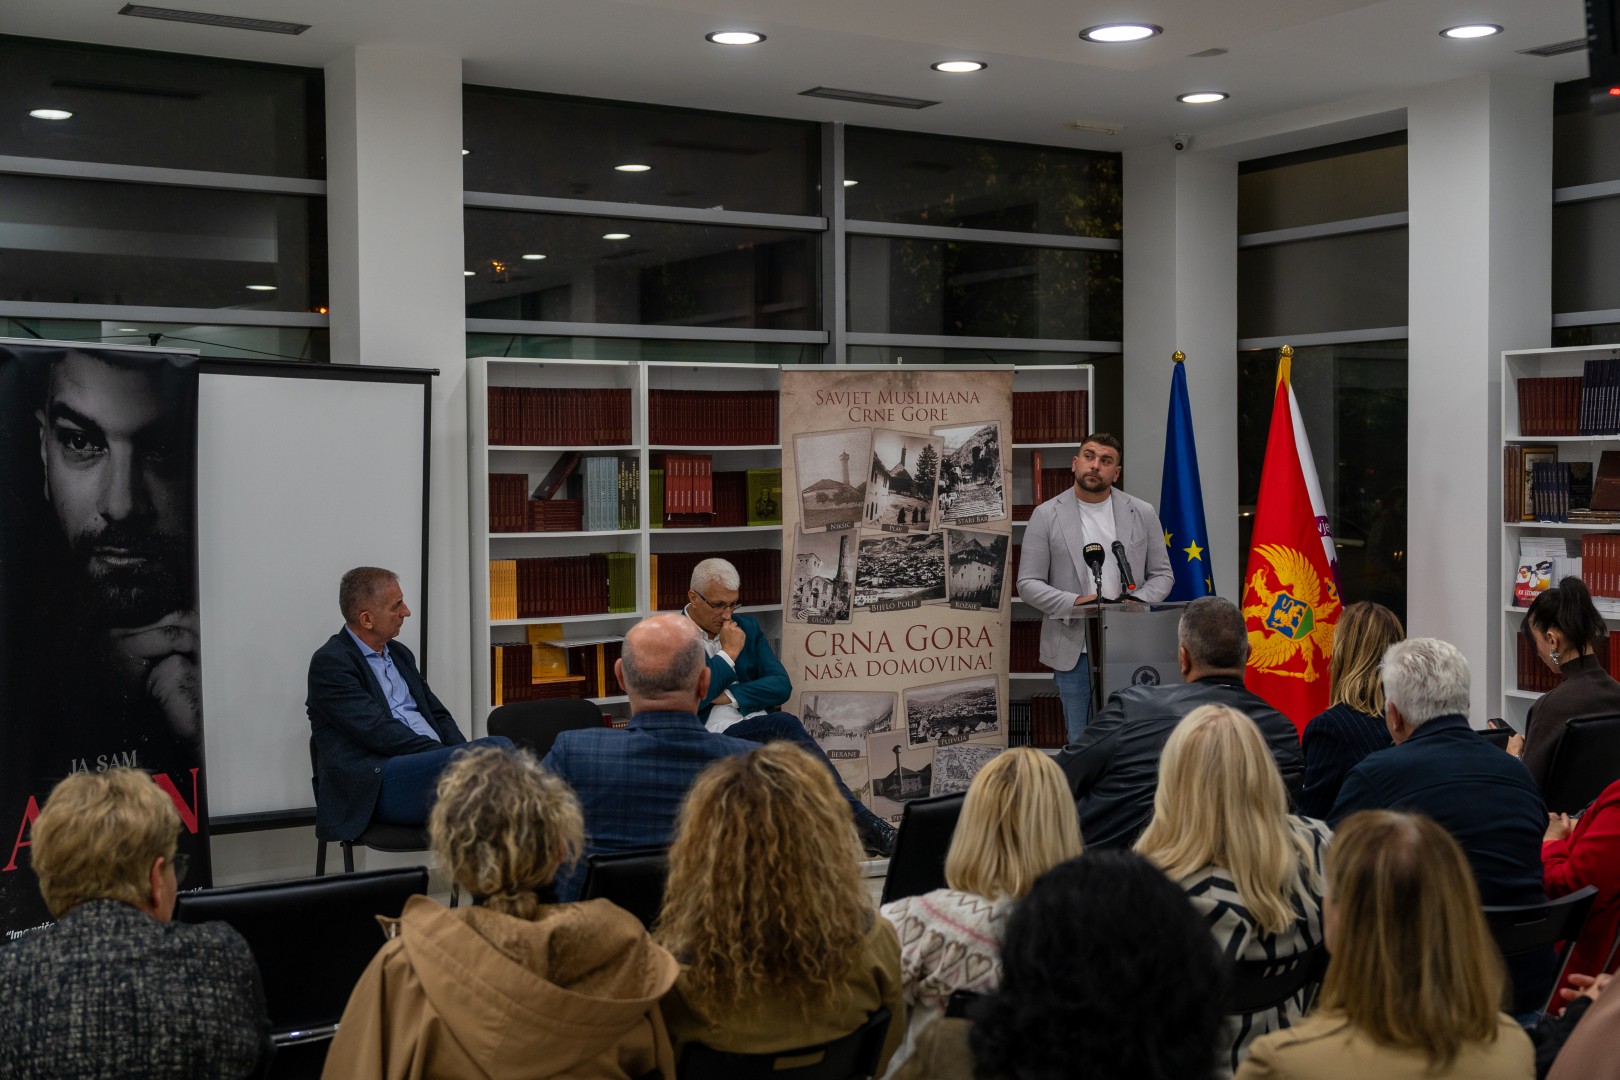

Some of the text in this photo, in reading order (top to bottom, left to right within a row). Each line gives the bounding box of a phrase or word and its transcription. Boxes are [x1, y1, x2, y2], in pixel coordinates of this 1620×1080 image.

[816, 390, 980, 407] SAVJET MUSLIMANA
[848, 406, 948, 422] CRNE GORE
[871, 600, 918, 612] BIJELO POLJE
[804, 624, 994, 657] CRNA GORA
[804, 652, 992, 681] NAŠA DOMOVINA!
[68, 749, 137, 775] JA SAM
